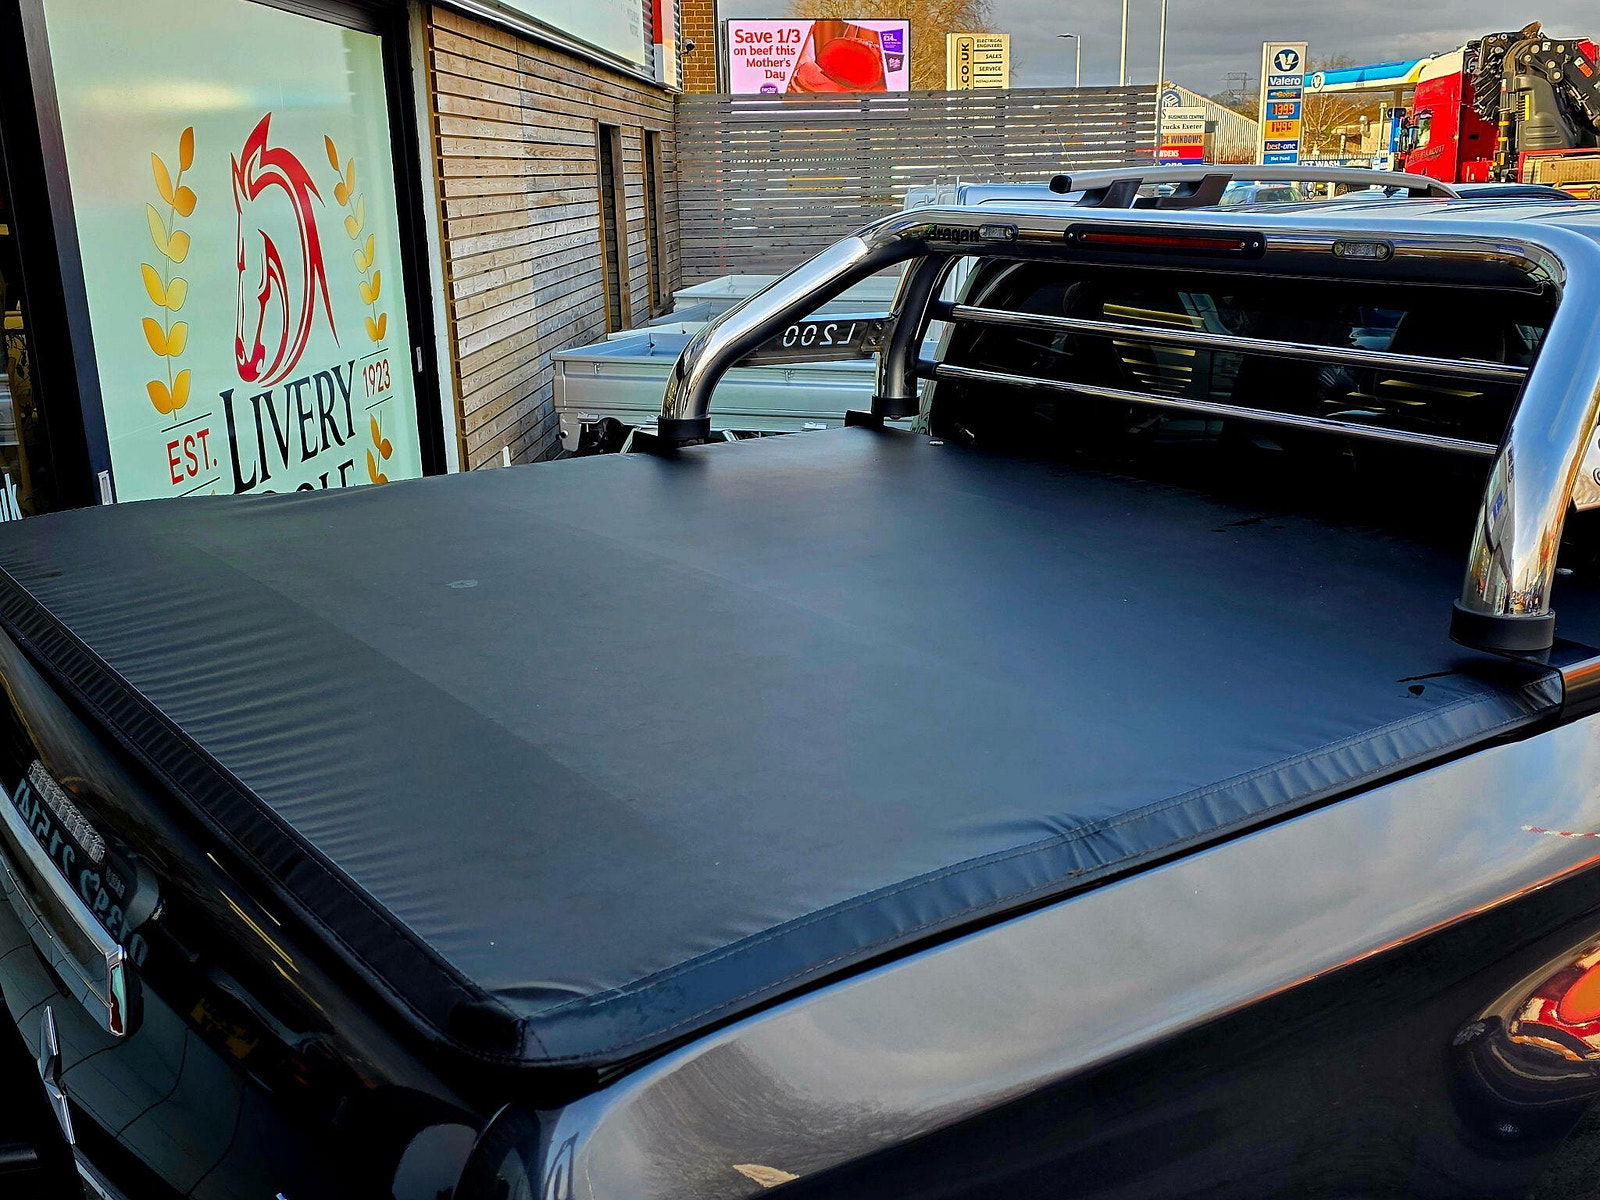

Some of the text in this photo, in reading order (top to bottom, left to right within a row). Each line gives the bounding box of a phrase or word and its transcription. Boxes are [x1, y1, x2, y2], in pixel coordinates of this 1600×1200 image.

[734, 28, 801, 44] Save 1/3
[733, 45, 796, 56] on beef this
[746, 57, 792, 68] Mother's
[764, 69, 786, 81] Day
[1269, 76, 1301, 86] Valero
[1170, 134, 1203, 144] WINDOWS
[1266, 142, 1296, 150] best-one
[362, 358, 391, 398] 1923
[166, 359, 357, 495] EST. LIVERY
